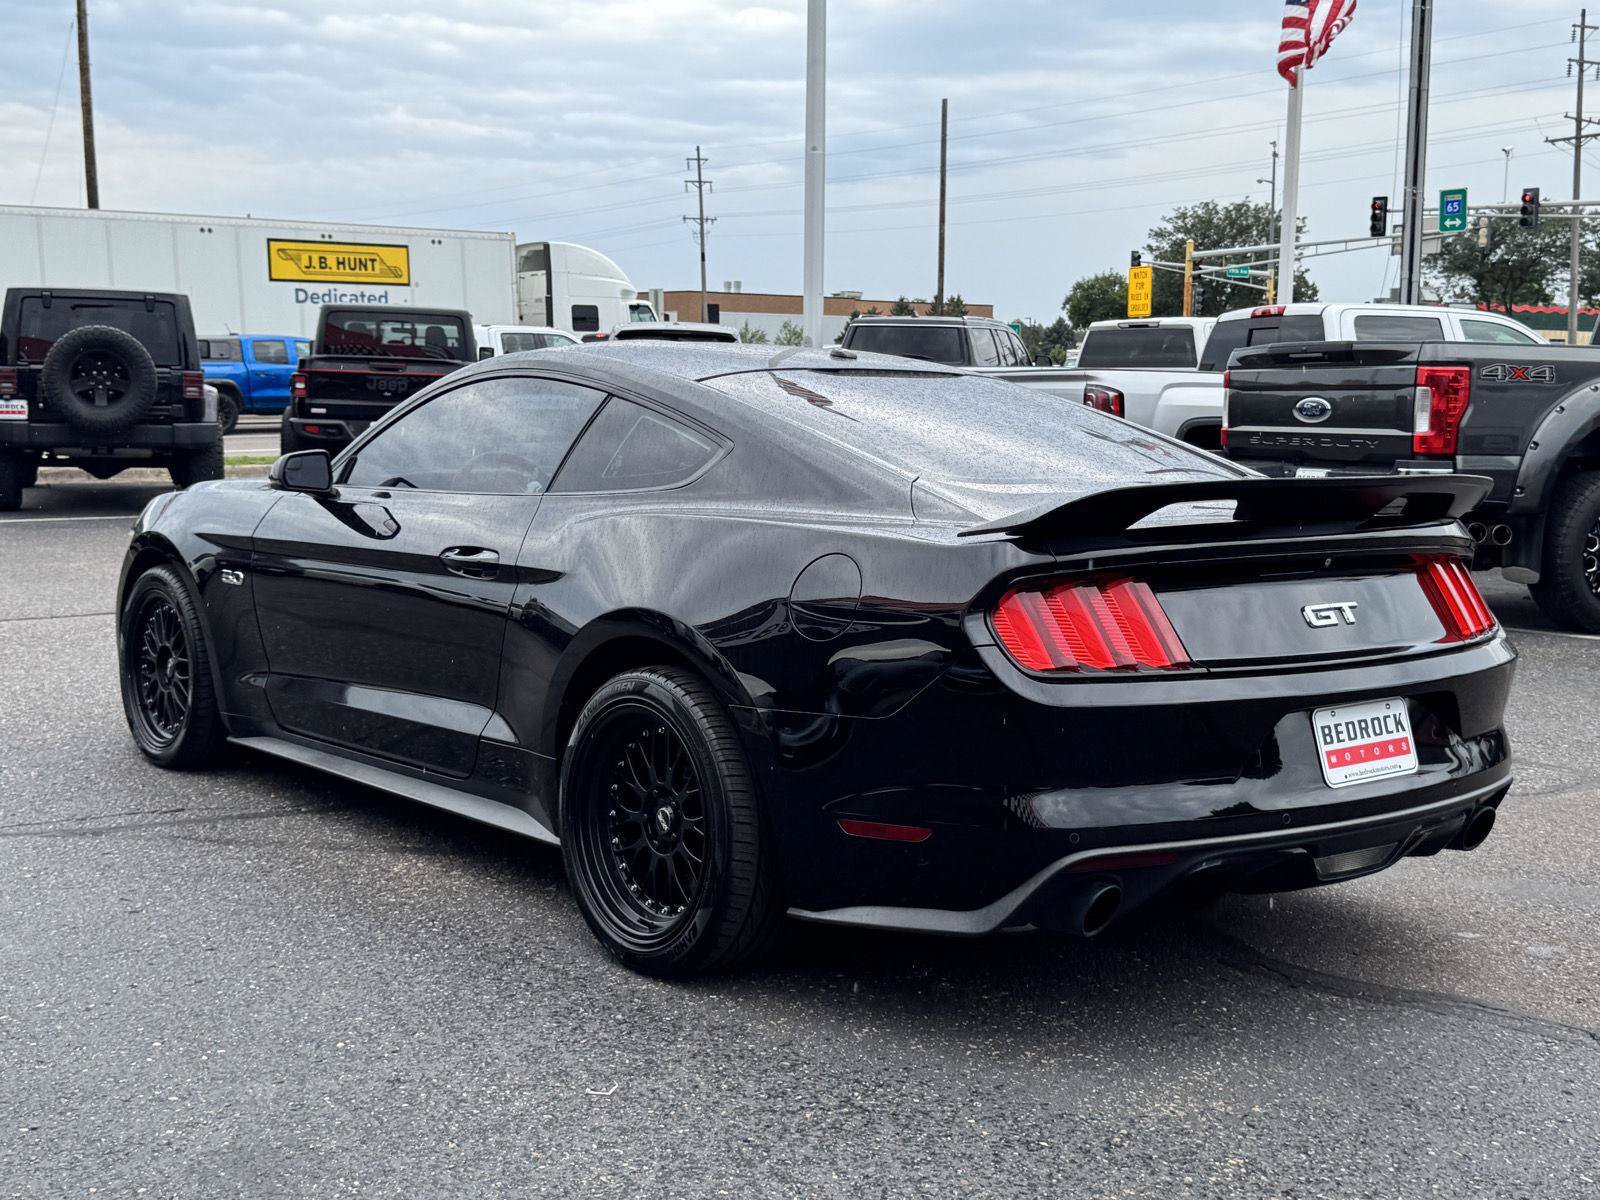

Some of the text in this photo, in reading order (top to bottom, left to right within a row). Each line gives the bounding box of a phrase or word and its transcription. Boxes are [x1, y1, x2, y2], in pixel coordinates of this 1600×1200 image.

[1446, 201, 1460, 213] 65
[336, 256, 377, 271] HUNT
[1133, 270, 1148, 279] WATCH
[1135, 282, 1145, 290] FOR
[294, 288, 389, 304] Dedicated
[366, 378, 408, 393] Jeep
[1249, 436, 1380, 449] SUPER DUTY
[1301, 601, 1358, 628] GT
[1320, 712, 1406, 746] BEDROCK
[1330, 742, 1407, 764] MOTORS
